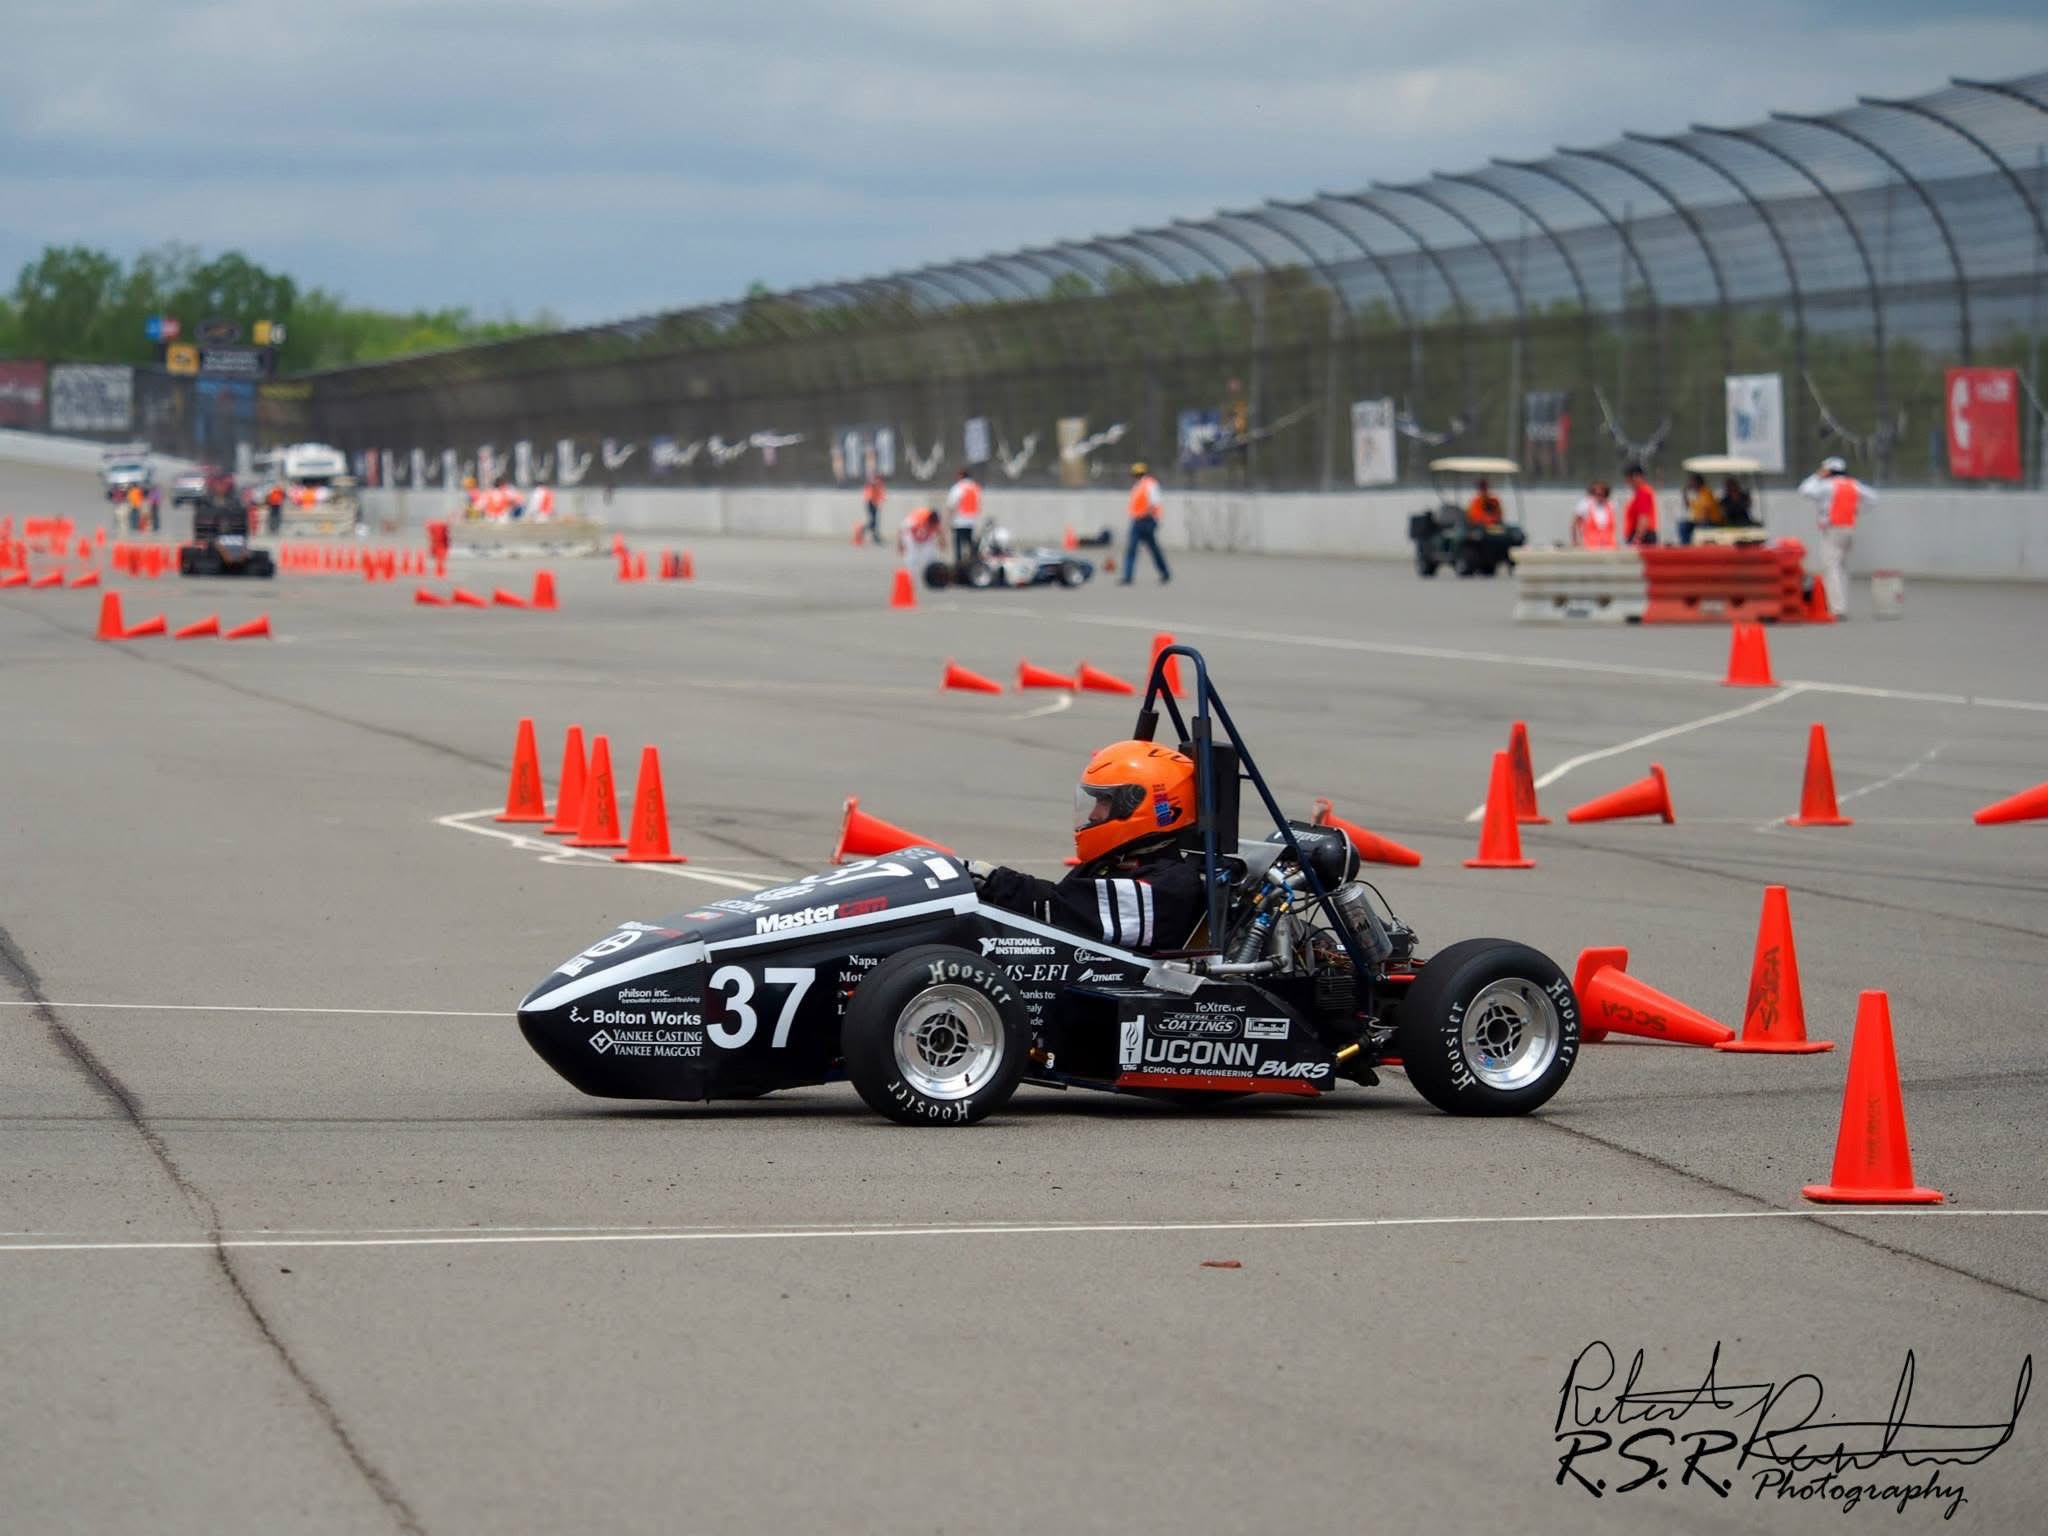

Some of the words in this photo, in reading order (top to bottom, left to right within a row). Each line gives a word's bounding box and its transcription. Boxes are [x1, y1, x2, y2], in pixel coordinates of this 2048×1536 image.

[756, 896, 888, 934] Mastercam
[996, 938, 1042, 946] NATIONAL
[995, 946, 1055, 955] INSTRUMENTS
[848, 954, 878, 969] Napa
[839, 971, 866, 982] Mot
[928, 960, 1011, 1003] Hoosier
[618, 988, 651, 1000] philson
[1020, 989, 1043, 999] hanks
[706, 965, 815, 1049] 37
[593, 1010, 646, 1024] Bolton
[651, 1011, 702, 1025] Works
[1158, 1018, 1234, 1032] COATINGS
[613, 1029, 654, 1041] YANKEE
[656, 1030, 702, 1042] CASTING
[614, 1045, 652, 1056] YANKEE
[654, 1046, 702, 1057] MAGCAST
[1144, 1038, 1258, 1066] UCONN
[1142, 1065, 1178, 1075] SCHOOL
[1180, 1067, 1193, 1075] OF
[1194, 1068, 1254, 1078] ENGINEERING
[1257, 1060, 1330, 1079] BMRS
